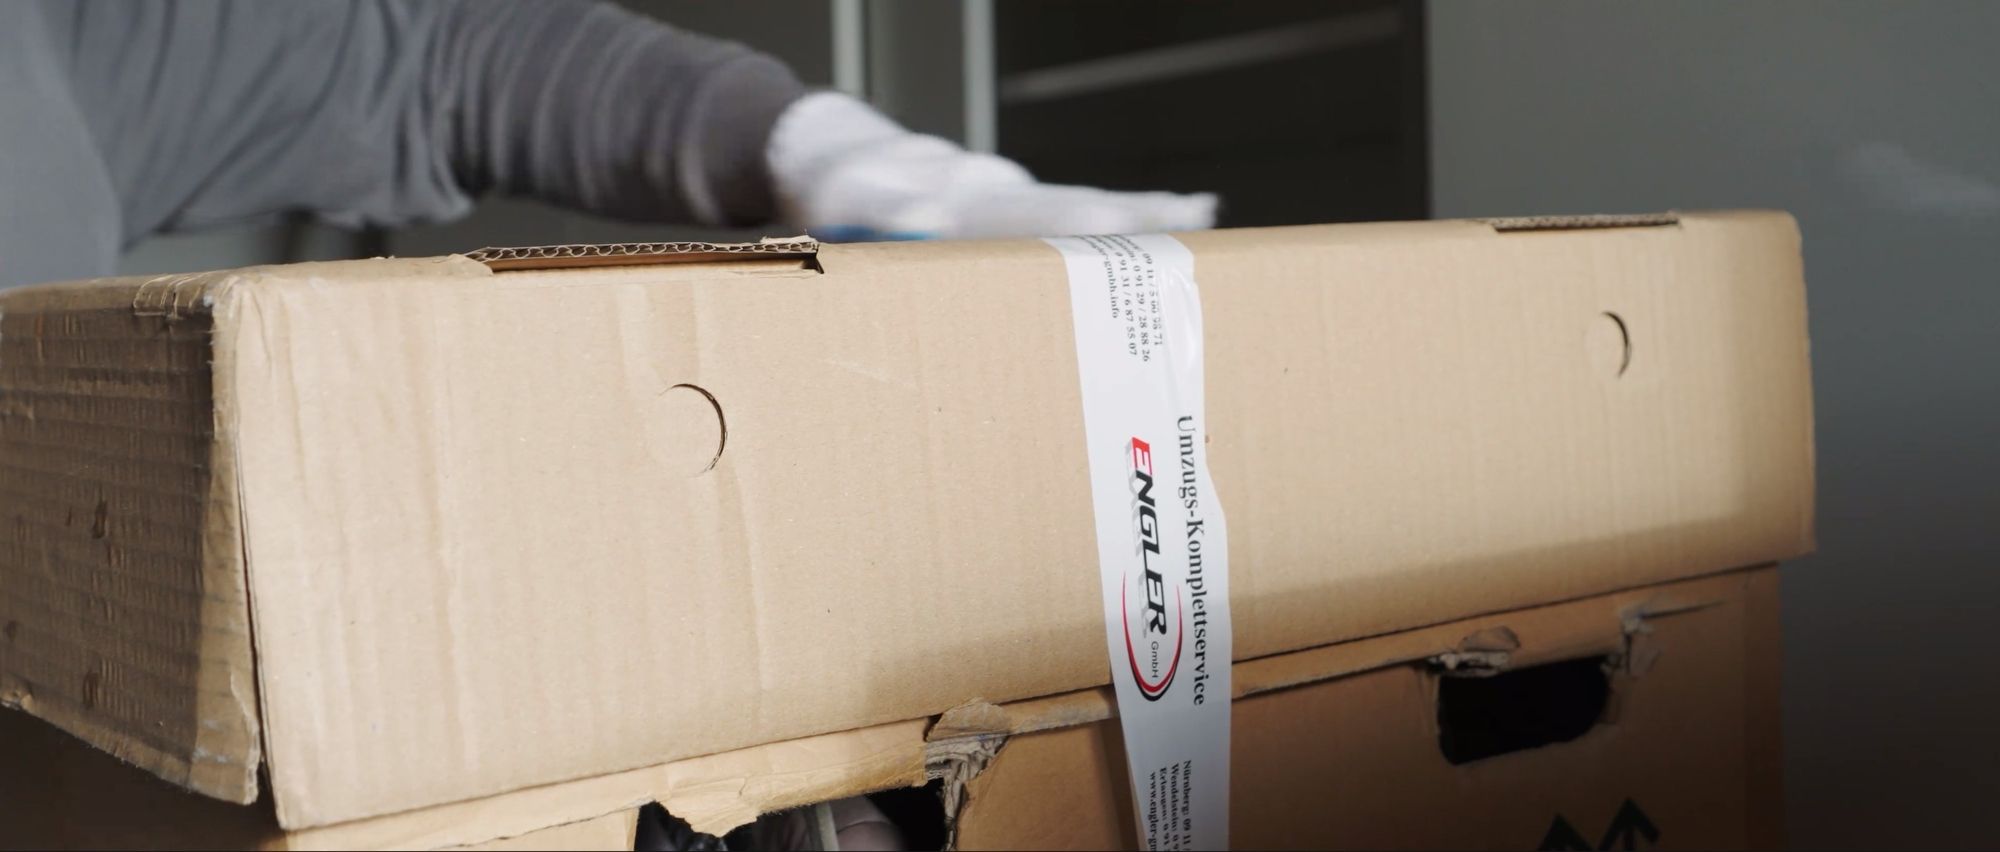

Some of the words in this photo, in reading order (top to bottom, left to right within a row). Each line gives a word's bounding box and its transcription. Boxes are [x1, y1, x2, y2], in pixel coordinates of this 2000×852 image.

[1119, 259, 1128, 271] 91
[1121, 277, 1131, 287] 31
[1135, 274, 1144, 287] 91
[1136, 292, 1145, 305] 29
[1125, 309, 1135, 322] 87
[1138, 316, 1148, 329] 28
[1126, 326, 1136, 339] 55
[1140, 332, 1149, 345] 88
[1154, 334, 1163, 346] 71
[1128, 342, 1138, 355] 07
[1141, 349, 1151, 362] 26
[1131, 436, 1167, 635] ENGLER
[1151, 641, 1159, 679] GmbH
[1177, 415, 1209, 706] Umzugs-Komplettservice
[1181, 760, 1192, 816] Nürnberg:
[1170, 763, 1179, 832] Wendelstein:
[1163, 823, 1169, 831] 0
[1183, 818, 1191, 831] 09
[1164, 833, 1170, 846] 91
[1172, 834, 1179, 842] 0
[1183, 835, 1191, 845] 11
